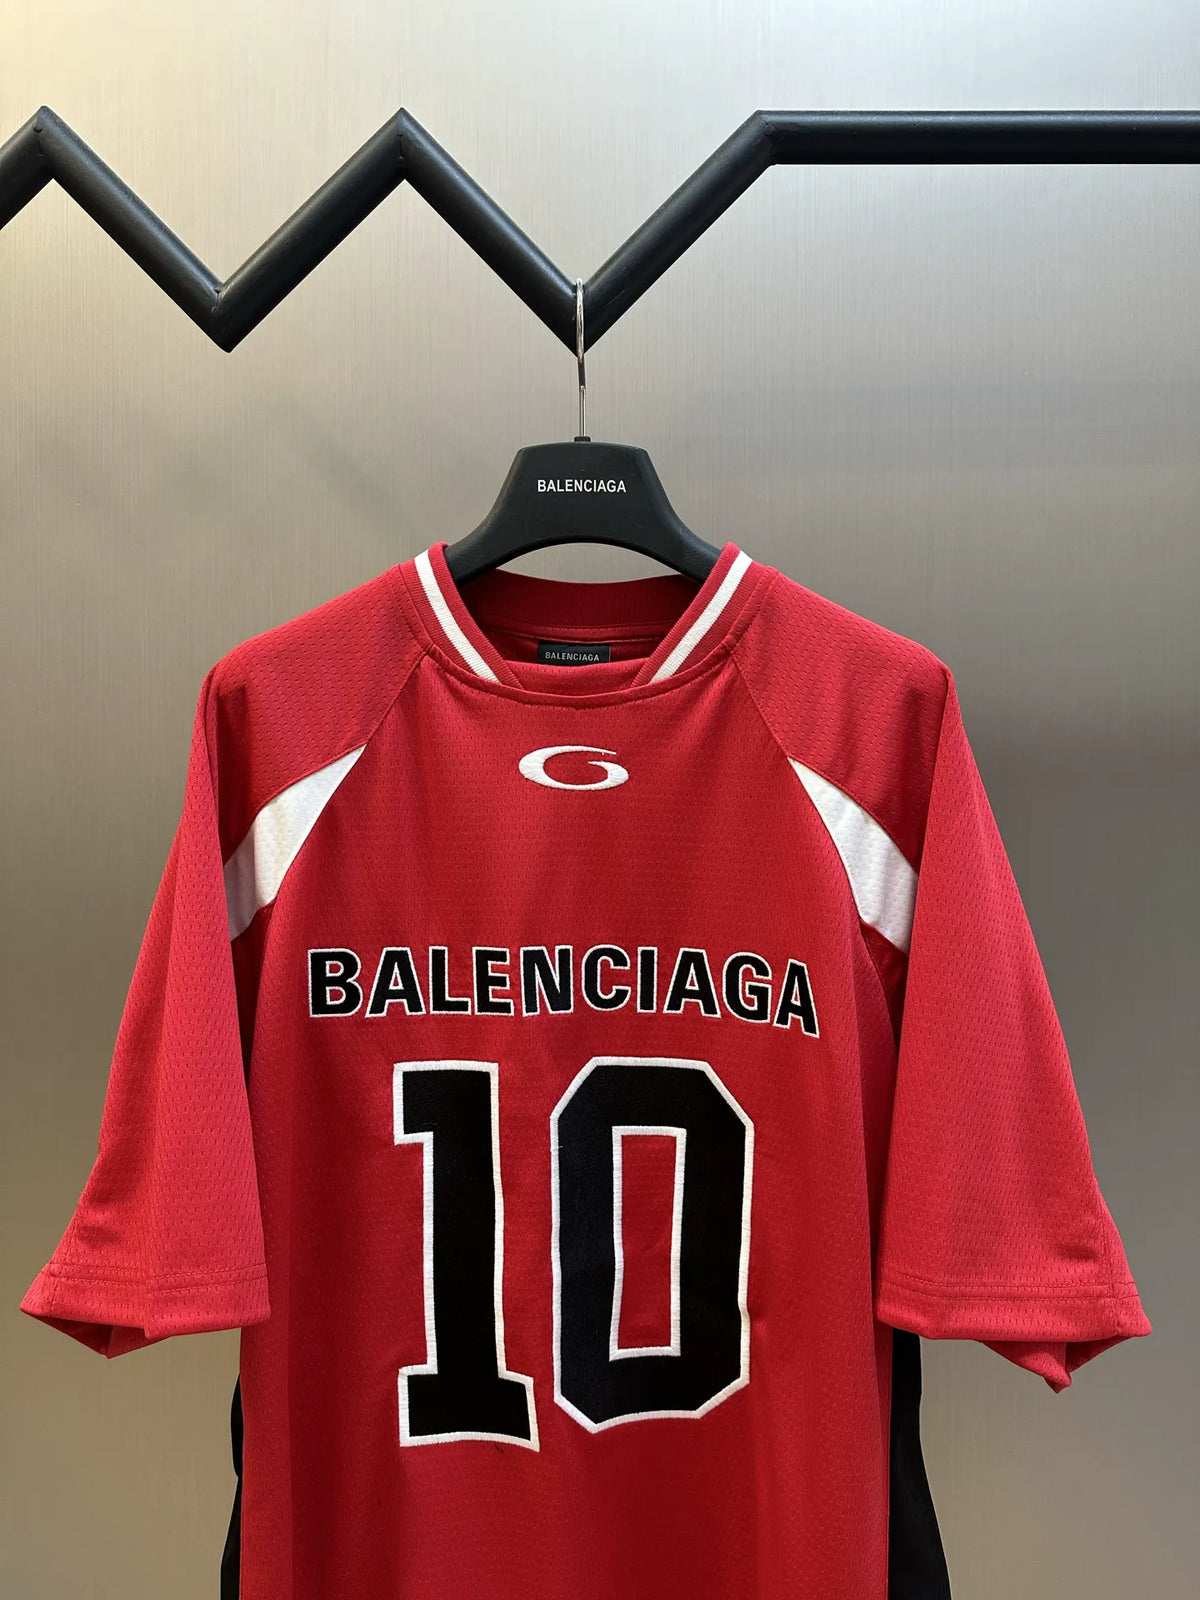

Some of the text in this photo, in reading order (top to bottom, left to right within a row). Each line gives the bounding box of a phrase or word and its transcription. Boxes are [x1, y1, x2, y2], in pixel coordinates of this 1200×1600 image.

[537, 479, 627, 493] BALENCIAGA
[545, 651, 600, 662] BALENCIAGA
[307, 944, 820, 1039] BALENCIAGA
[393, 1056, 755, 1452] 10
